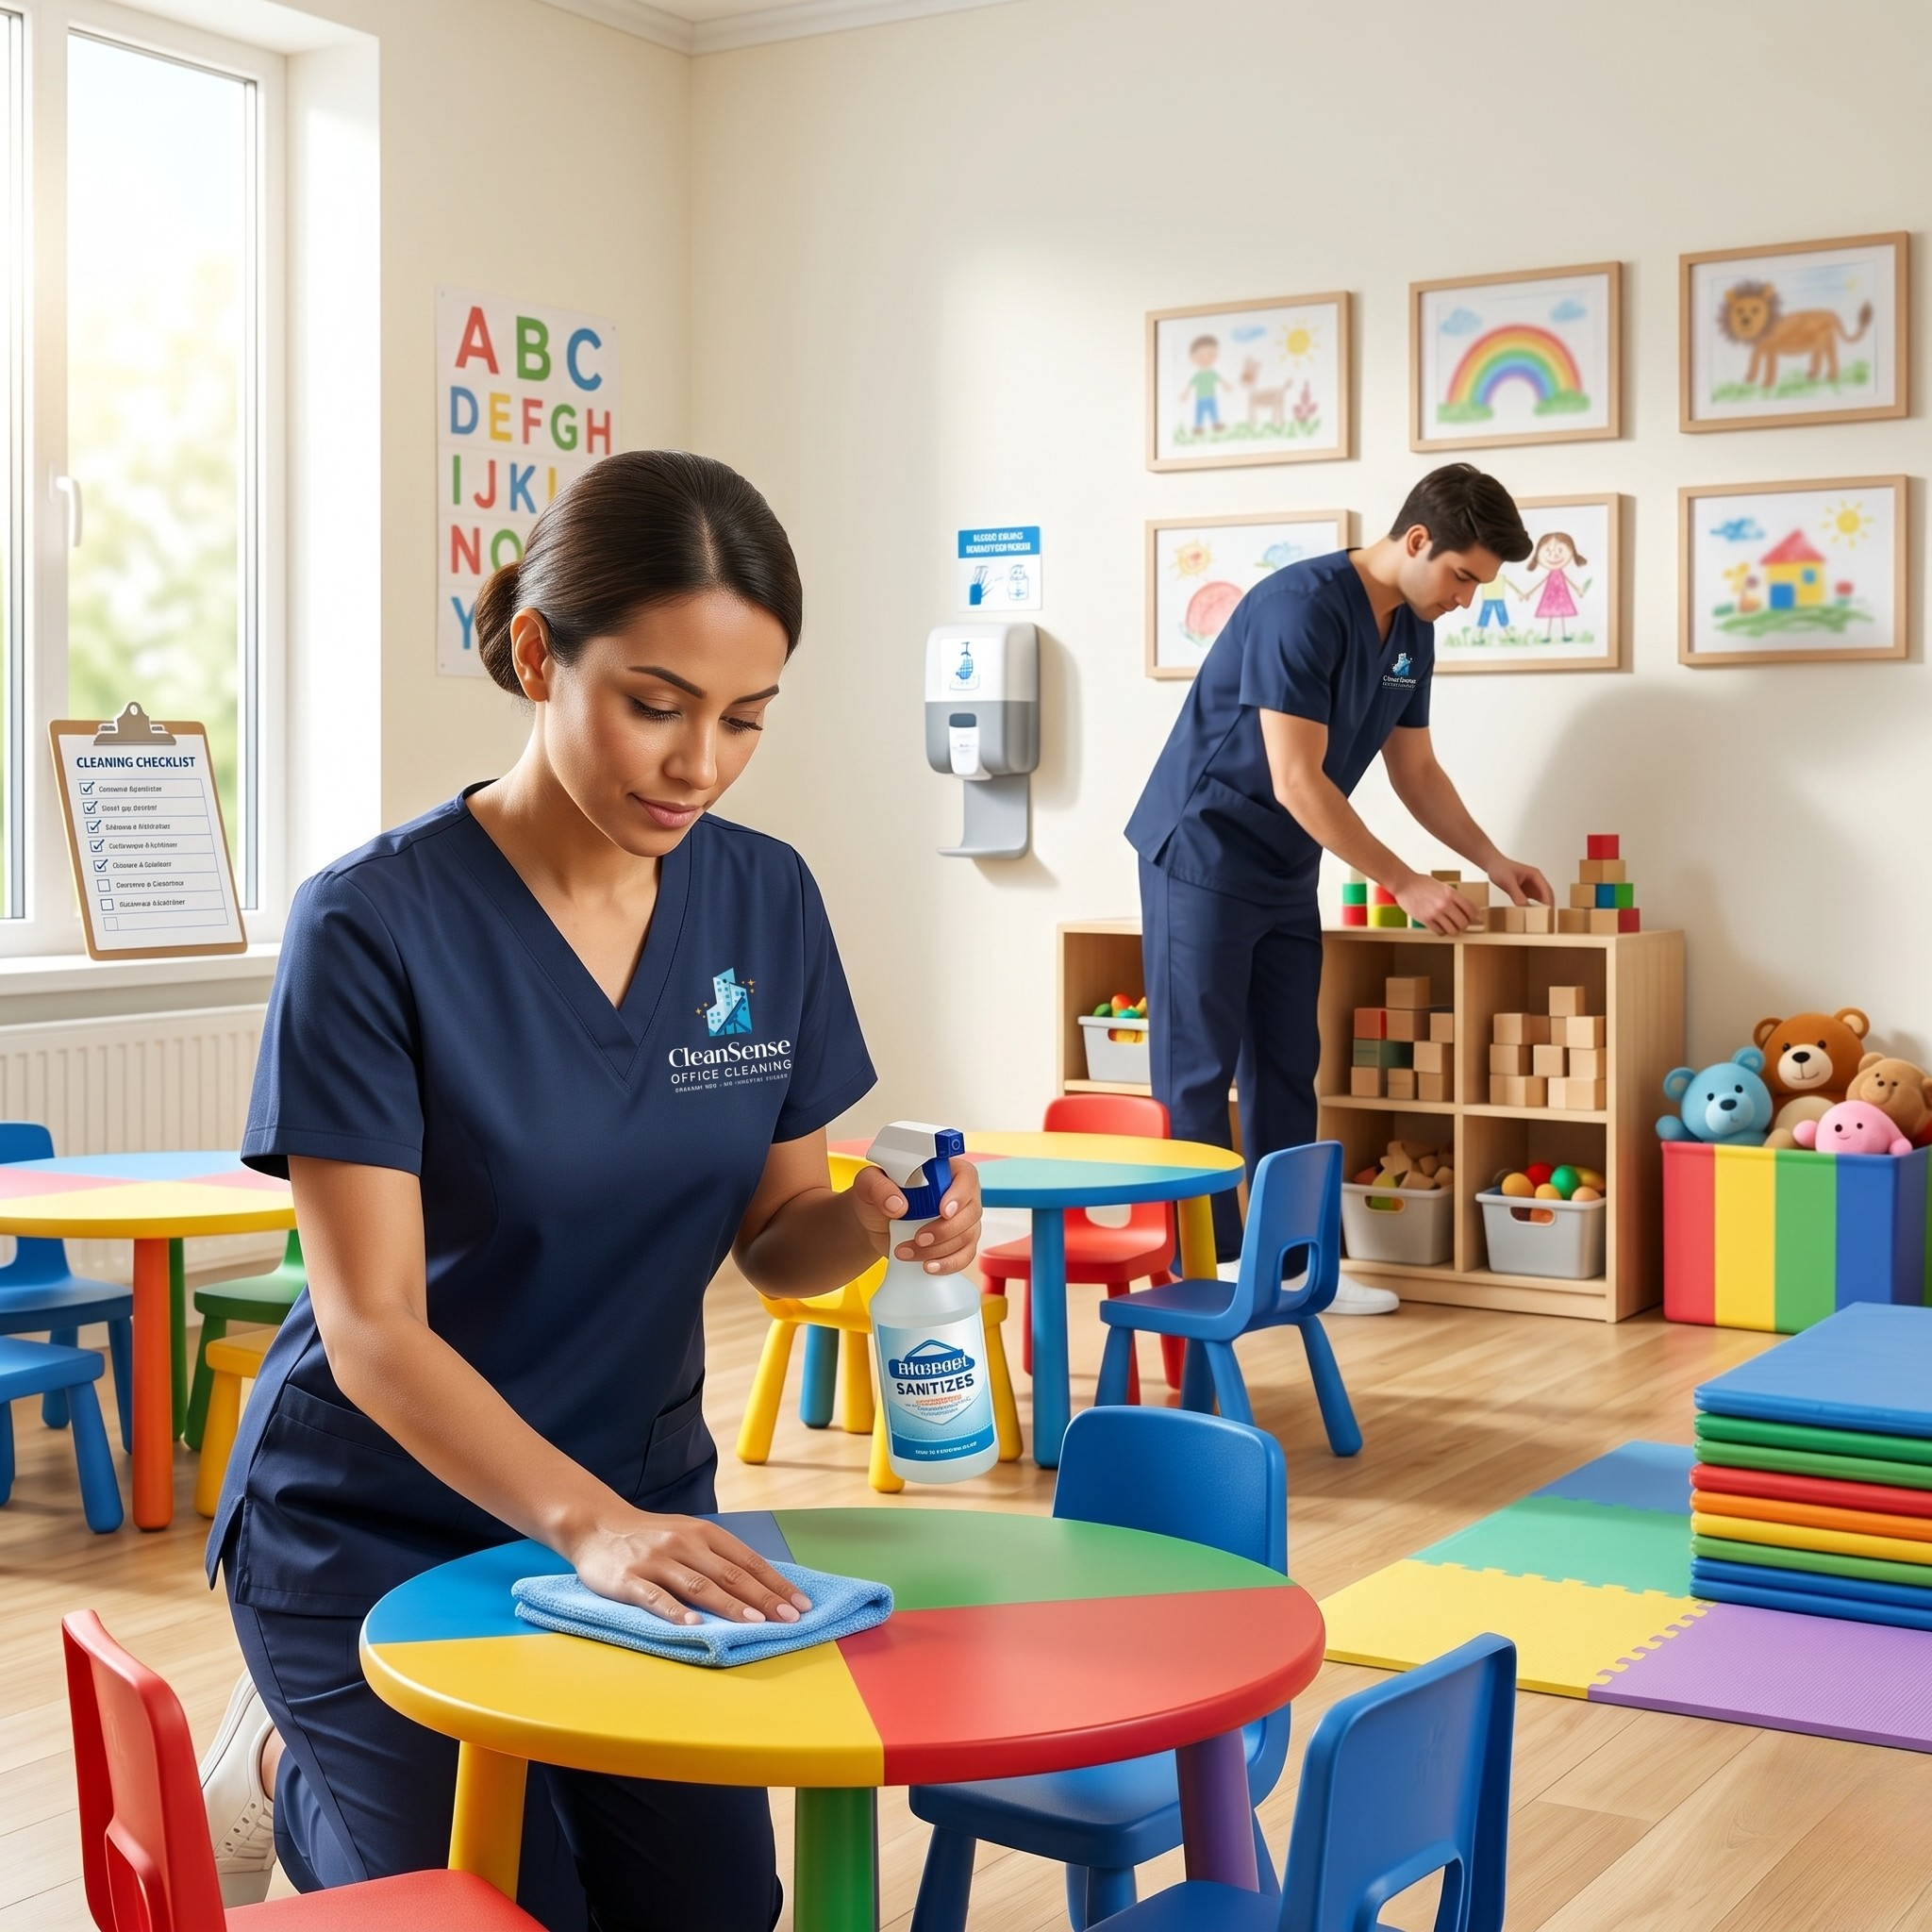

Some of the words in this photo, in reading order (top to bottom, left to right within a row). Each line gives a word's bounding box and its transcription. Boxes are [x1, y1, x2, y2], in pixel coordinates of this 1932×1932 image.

[76, 757, 133, 768] CLEANING
[136, 757, 195, 768] CHECKLIST
[668, 1040, 791, 1068] CleanSense
[671, 1069, 719, 1084] OFFICE
[724, 1058, 792, 1077] CLEANING
[897, 1374, 974, 1396] SANITIZES
